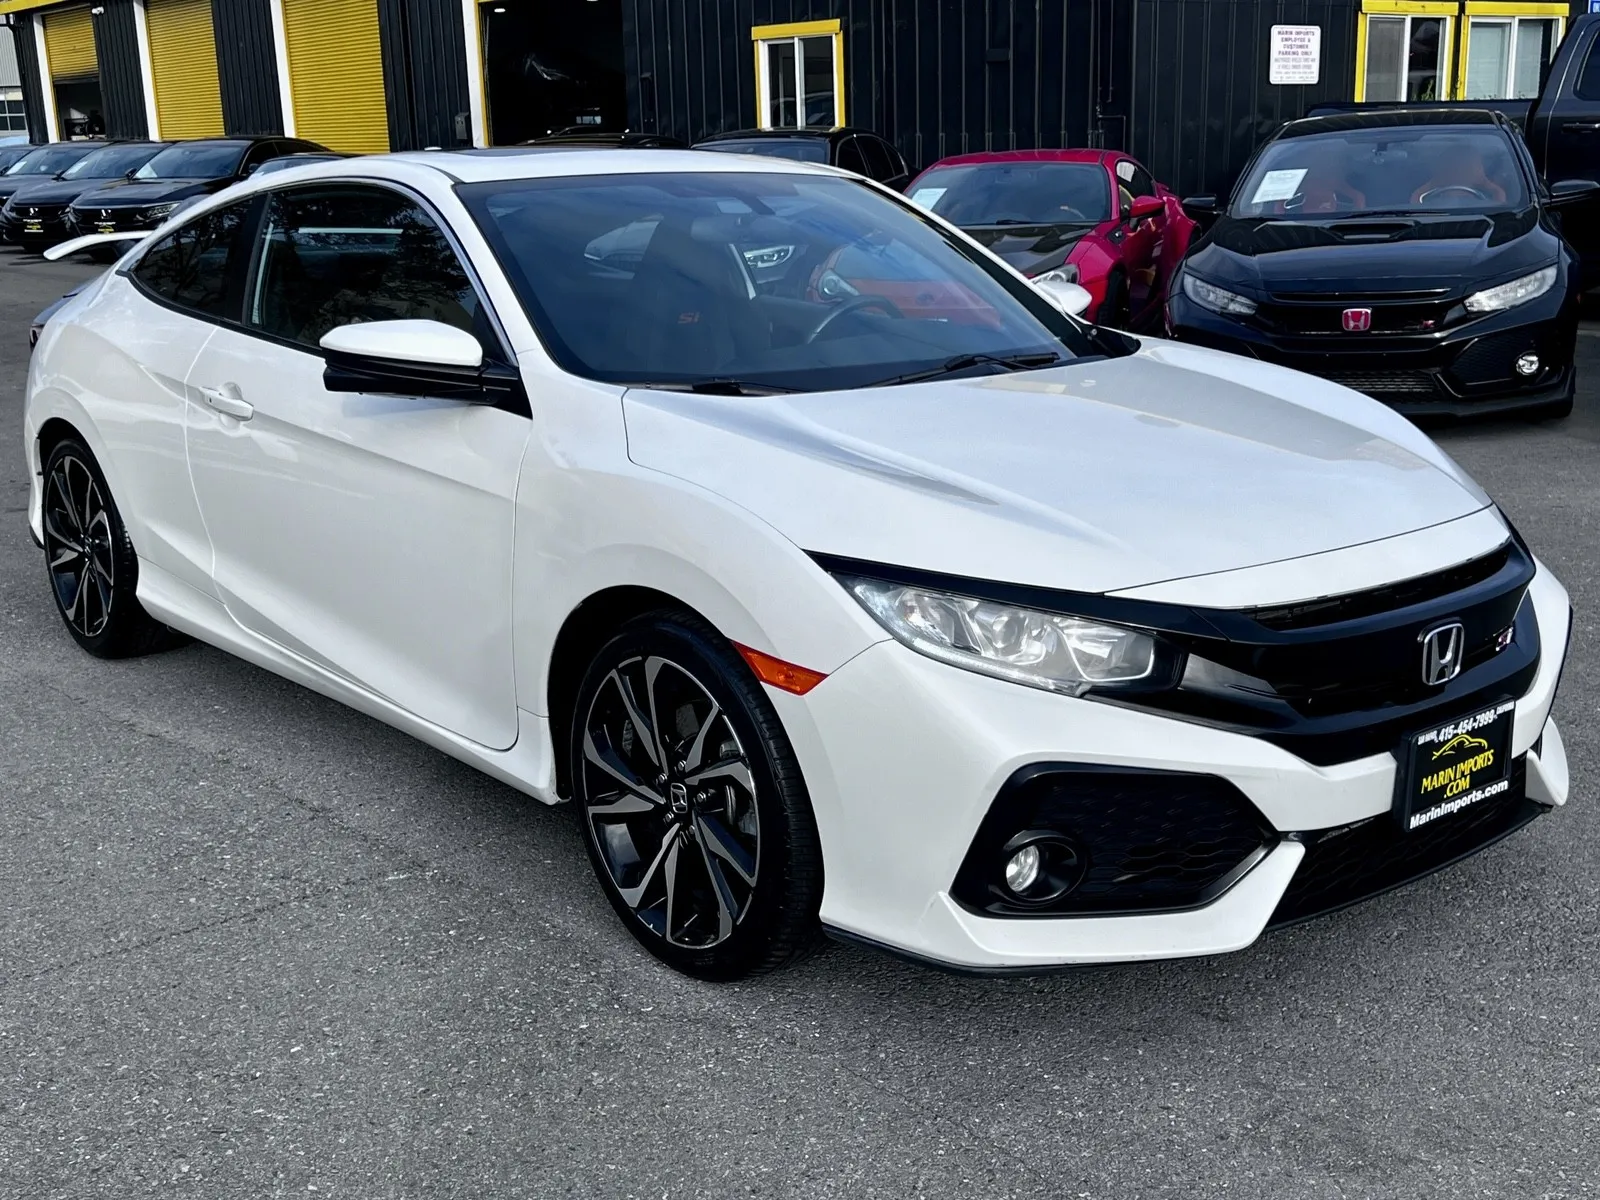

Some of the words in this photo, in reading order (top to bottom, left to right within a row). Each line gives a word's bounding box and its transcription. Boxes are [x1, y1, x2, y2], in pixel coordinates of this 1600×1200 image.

[1421, 766, 1455, 794] MARIN
[1456, 749, 1494, 779] IMPORTS
[1409, 780, 1508, 829] MarinImports.com
